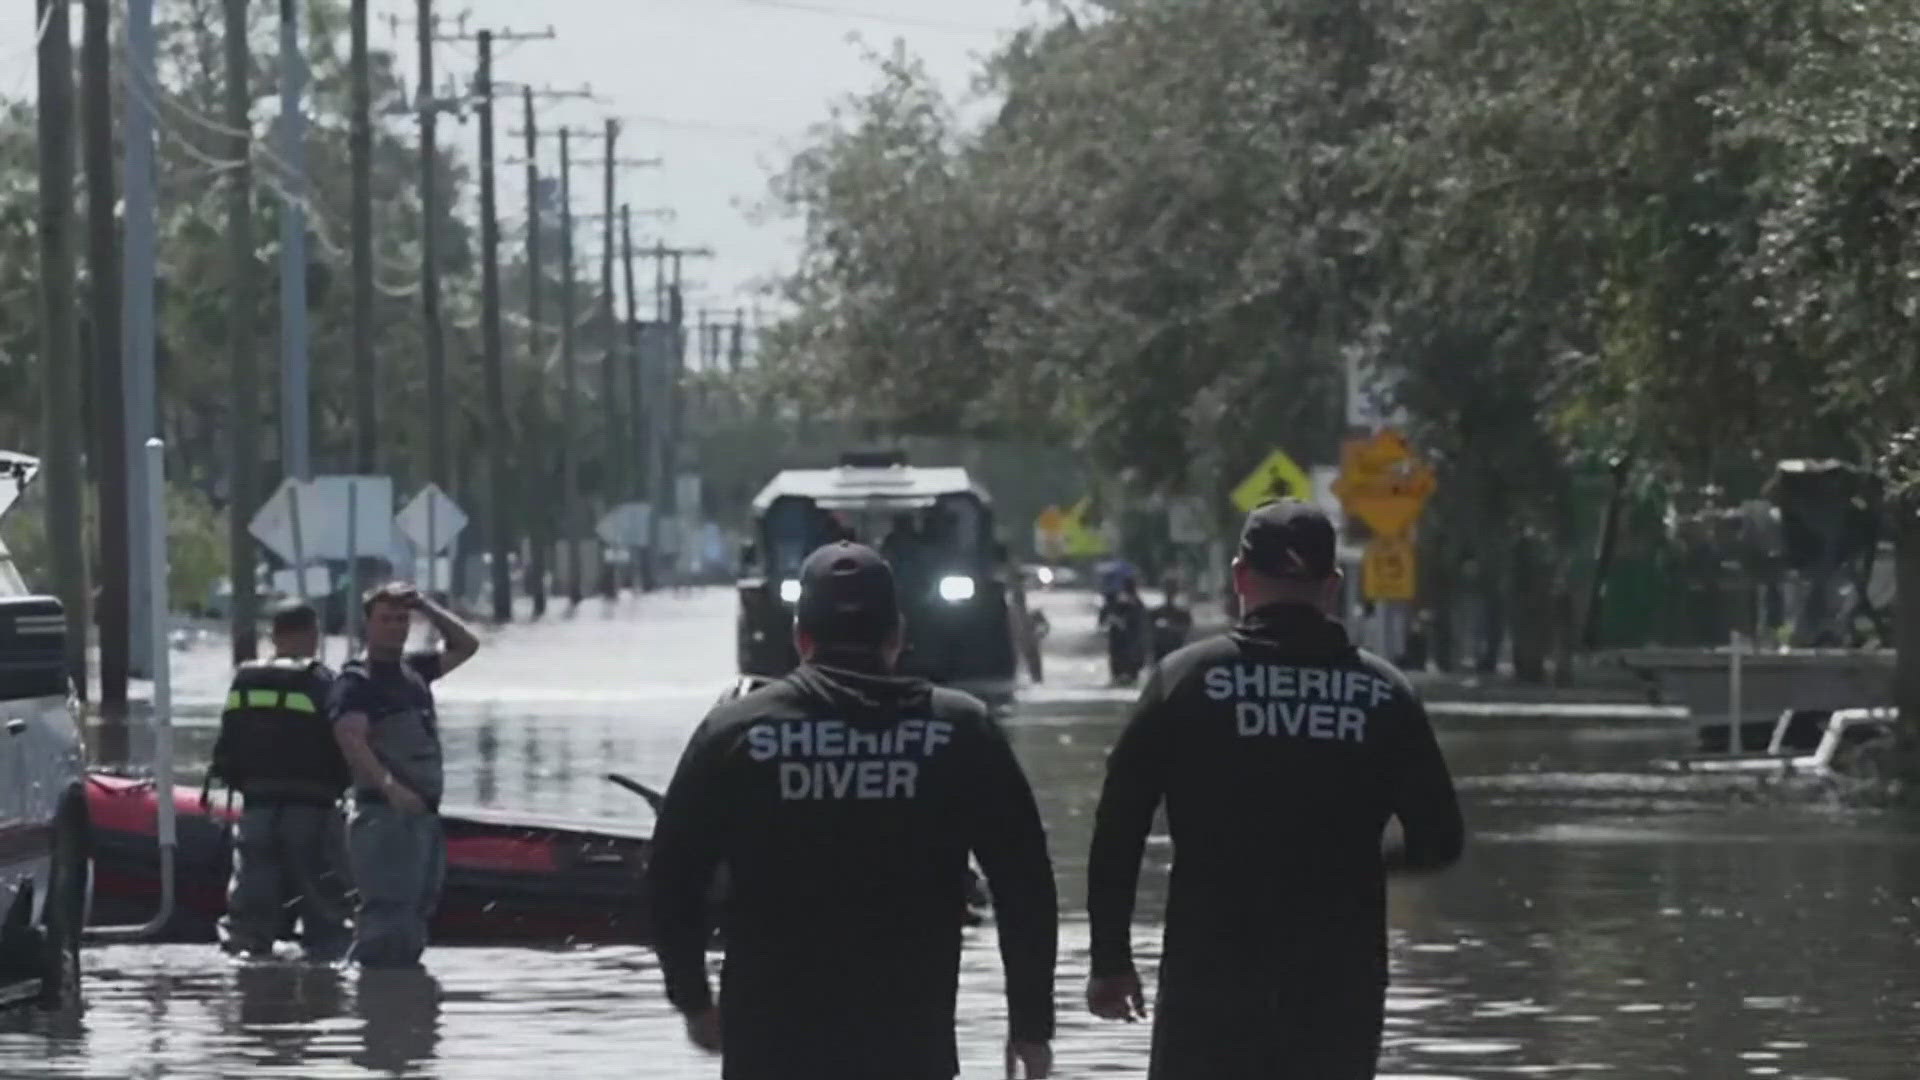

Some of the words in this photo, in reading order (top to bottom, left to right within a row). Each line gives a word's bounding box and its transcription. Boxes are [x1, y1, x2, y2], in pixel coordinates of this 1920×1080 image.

[1204, 664, 1393, 707] SHERIFF
[747, 721, 953, 761] SHERIFF
[1235, 702, 1366, 743] DIVER
[780, 761, 917, 799] DIVER
